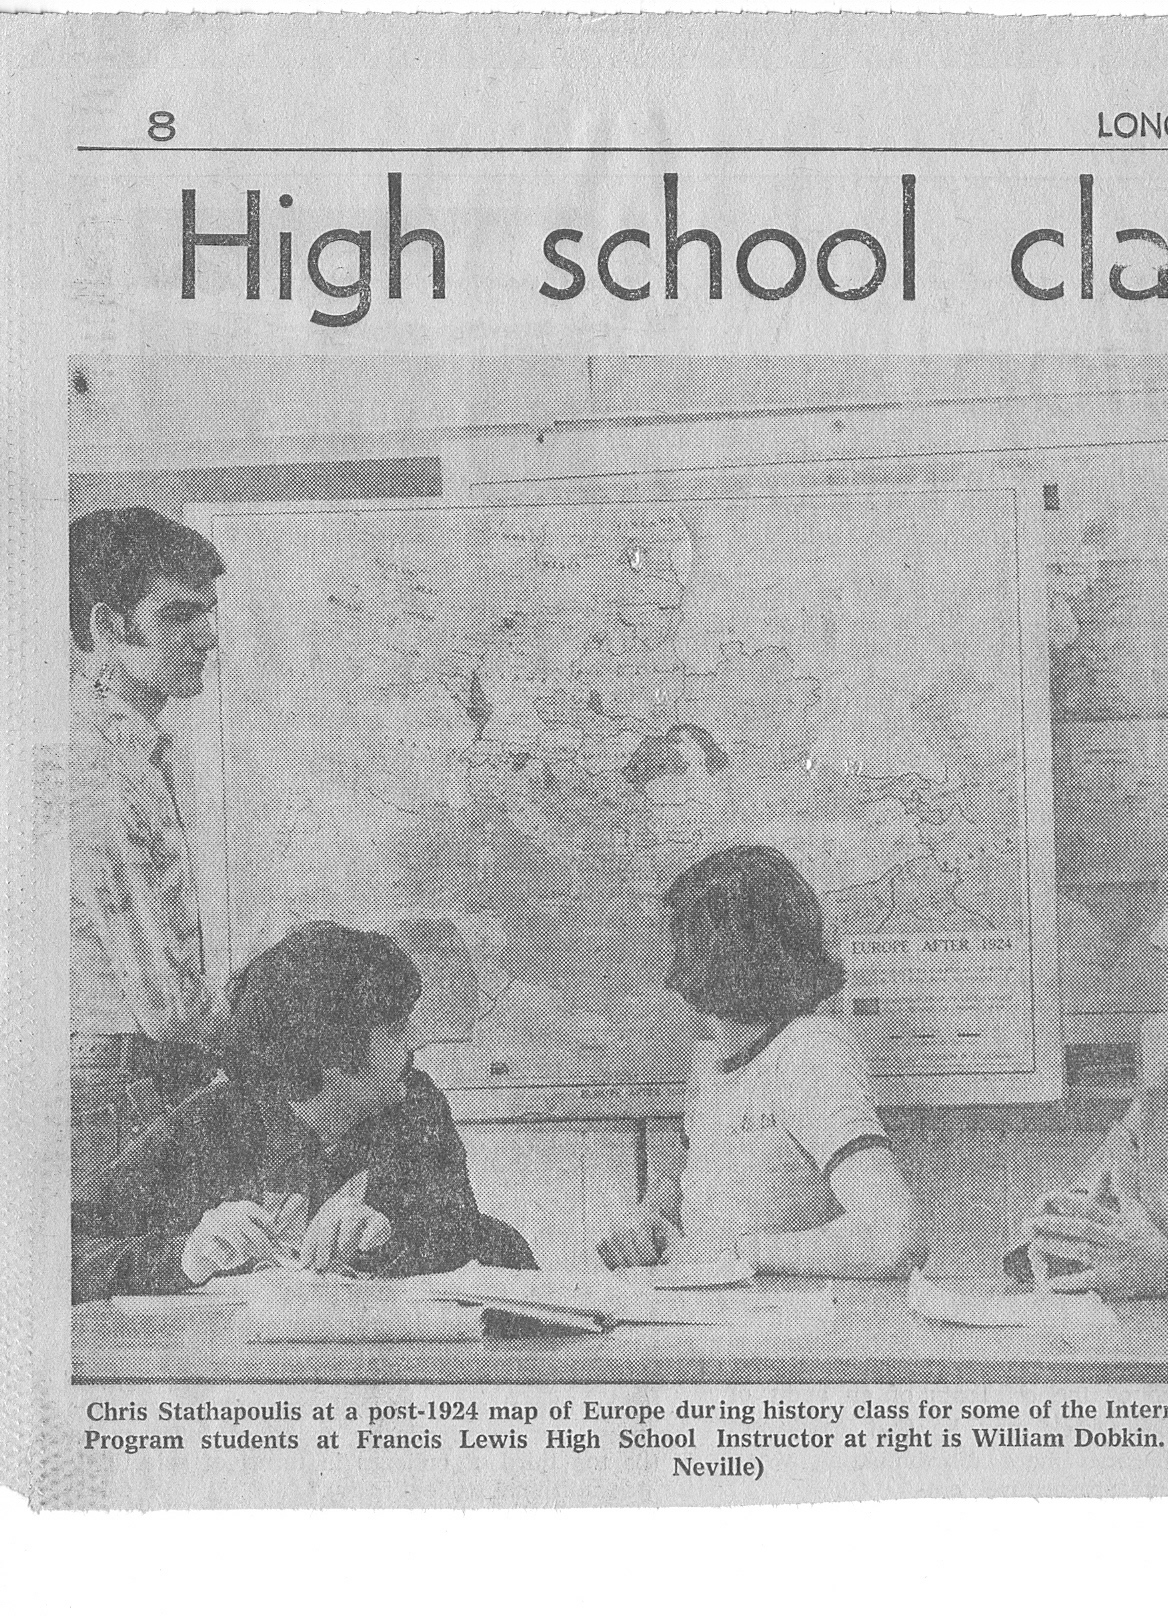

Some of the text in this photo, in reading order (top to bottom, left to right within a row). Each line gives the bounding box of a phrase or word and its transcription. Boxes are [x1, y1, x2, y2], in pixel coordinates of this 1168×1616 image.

[147, 111, 176, 142] 8
[181, 172, 446, 328] High
[538, 172, 916, 302] school
[851, 937, 1013, 954] EUROPE AFTER 1924
[86, 1401, 148, 1422] Chris
[158, 1400, 302, 1425] Stathapoulis
[312, 1403, 334, 1421] at
[345, 1406, 358, 1421] a
[368, 1401, 479, 1425] post-1924
[489, 1406, 538, 1425] map
[549, 1400, 573, 1420] of
[583, 1401, 665, 1424] Europe
[676, 1400, 755, 1425] during
[763, 1400, 844, 1424] history
[853, 1399, 909, 1419] class
[919, 1400, 953, 1419] for
[961, 1405, 1020, 1420] some
[1029, 1399, 1052, 1419] of
[1061, 1399, 1097, 1419] the
[84, 1430, 184, 1455] Program
[201, 1429, 299, 1449] students
[316, 1431, 339, 1449] at
[356, 1429, 442, 1449] Francis
[460, 1429, 528, 1449] Lewis
[546, 1428, 601, 1454] High
[619, 1428, 695, 1449] School
[717, 1429, 835, 1448] Instructor
[844, 1430, 866, 1448] at
[876, 1427, 932, 1453] right
[942, 1428, 962, 1448] is
[972, 1427, 1065, 1448] William
[1074, 1427, 1165, 1448] Dobkin.
[672, 1456, 764, 1481] Neville)
